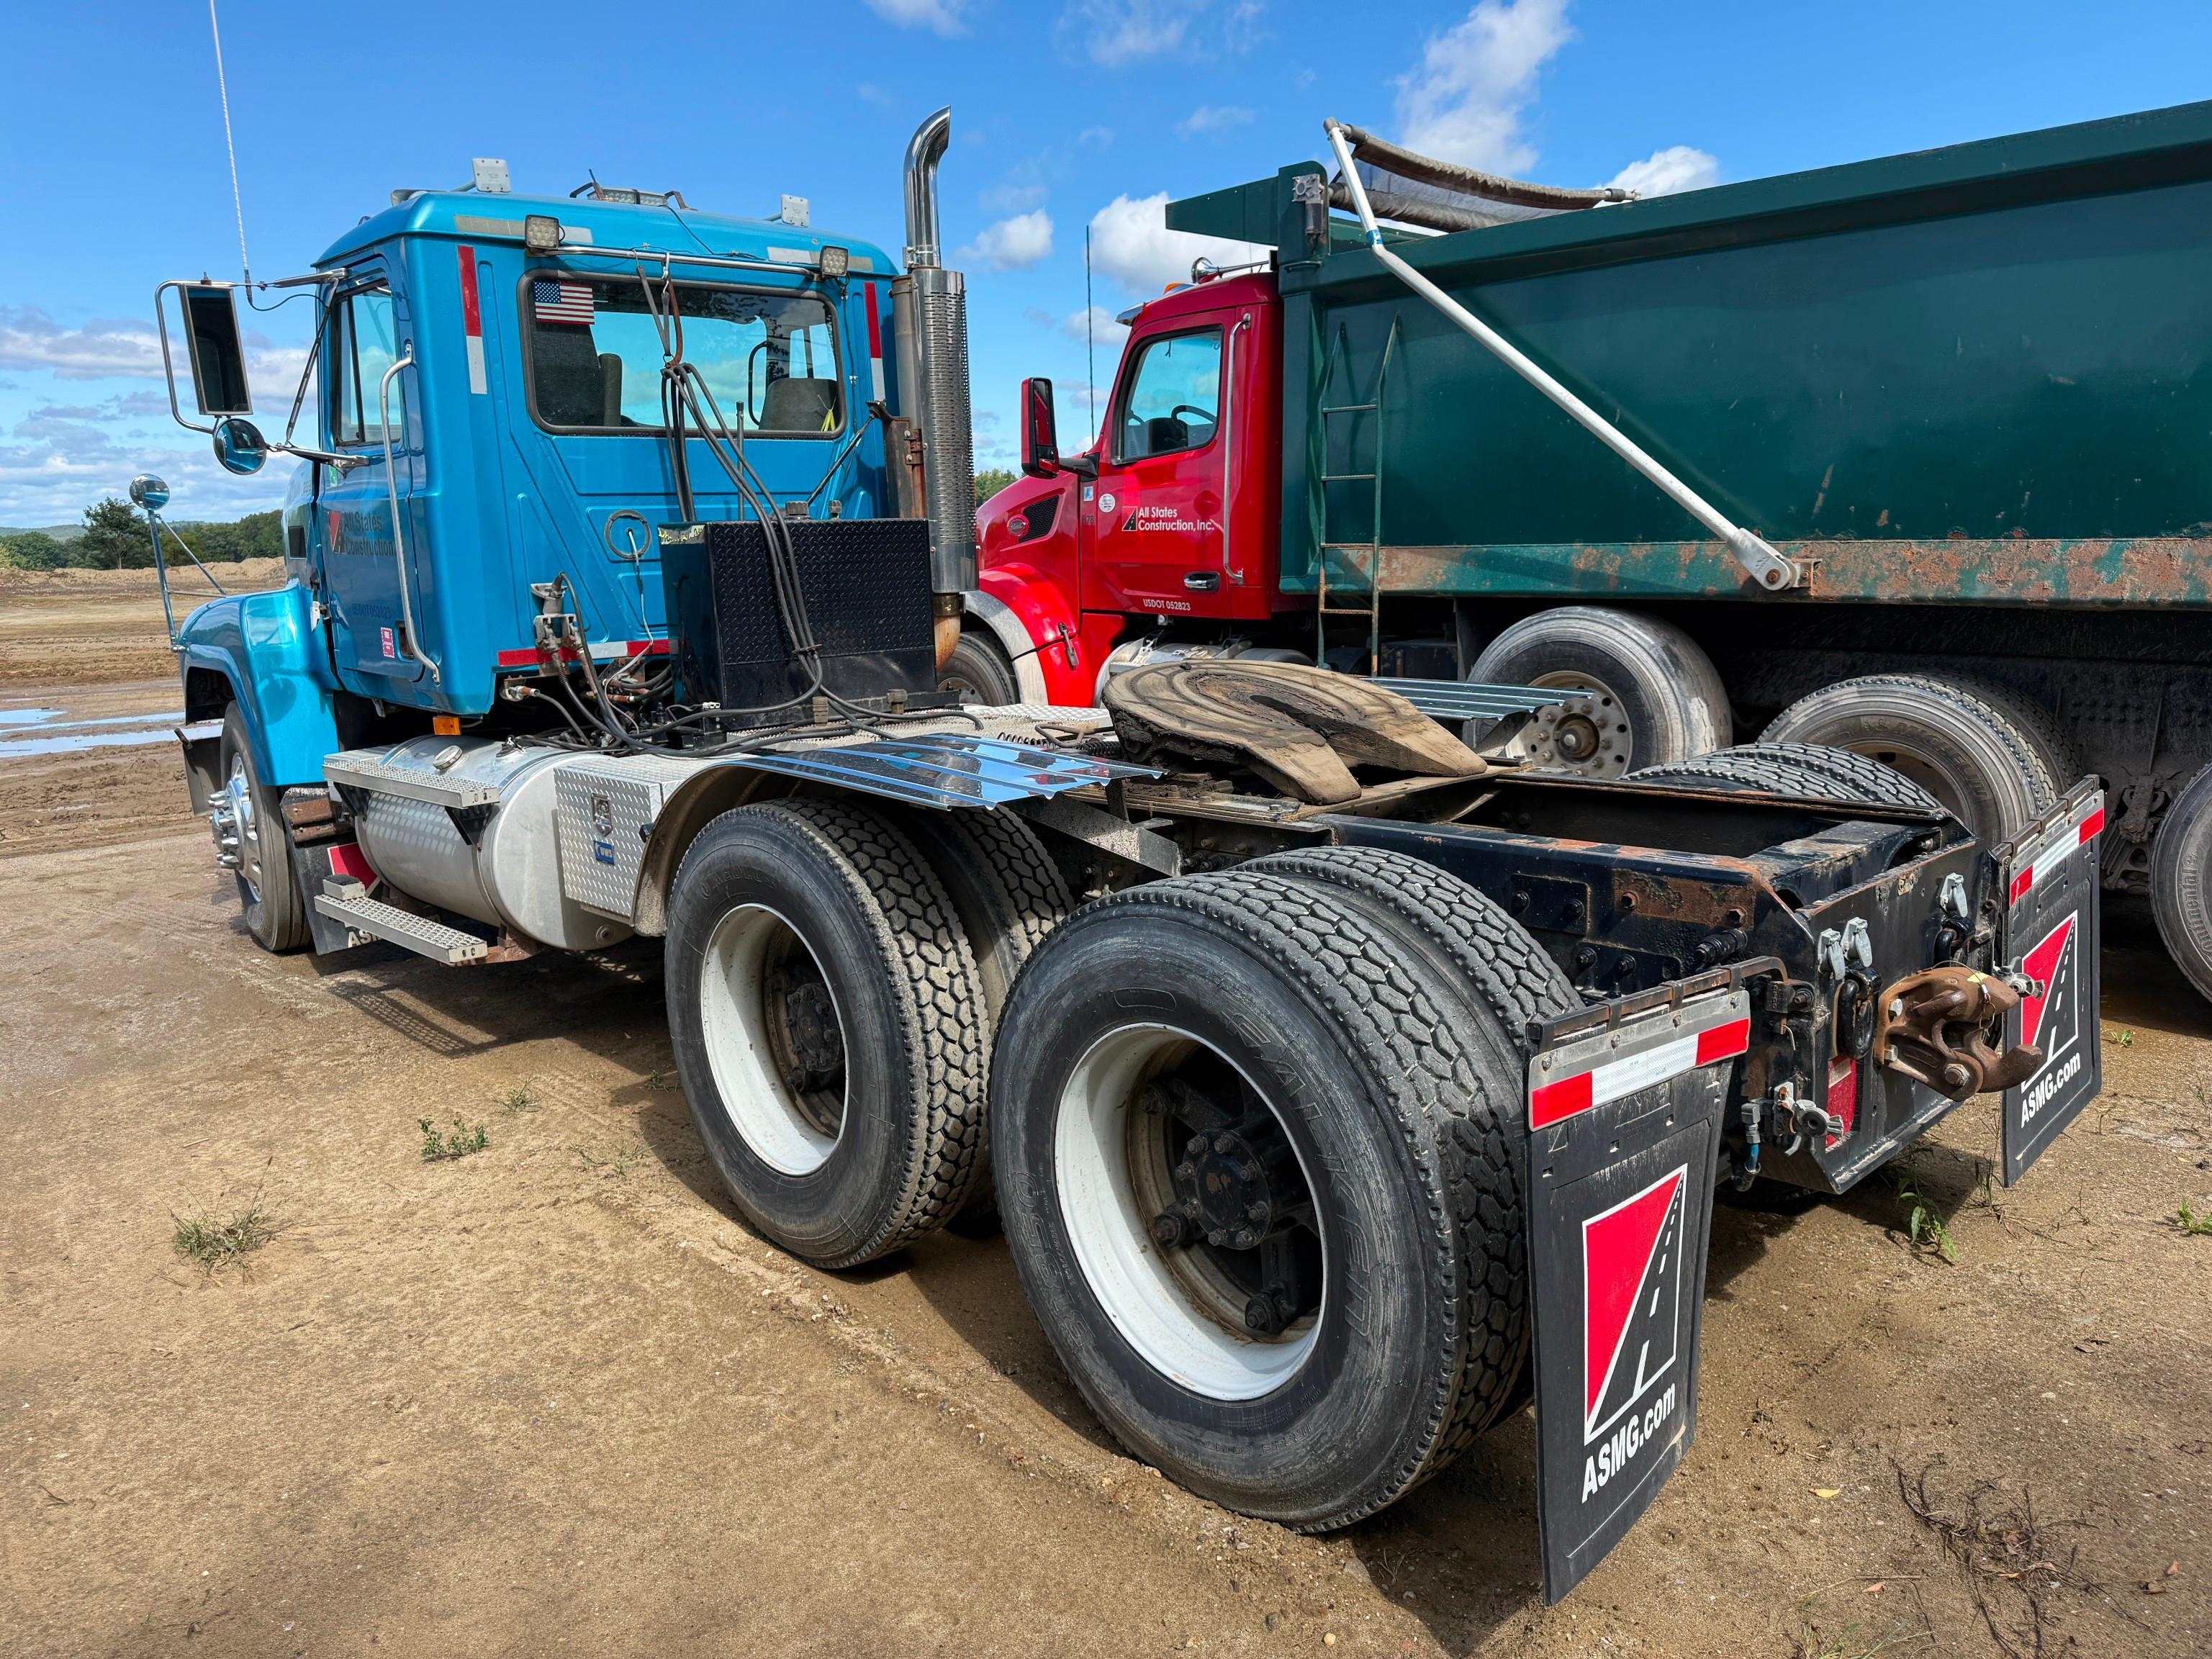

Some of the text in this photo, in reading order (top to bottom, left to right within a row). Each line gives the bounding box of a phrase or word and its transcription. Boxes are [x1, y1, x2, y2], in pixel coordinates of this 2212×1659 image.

[344, 512, 383, 533] All States
[1138, 507, 1178, 518] All States
[1138, 520, 1215, 532] Construction, Inc.
[1142, 598, 1191, 611] USDOT 052823
[2182, 867, 2212, 954] ontinental
[2021, 1052, 2081, 1129] ASMG.com
[1581, 1382, 1676, 1504] ASMG.com
